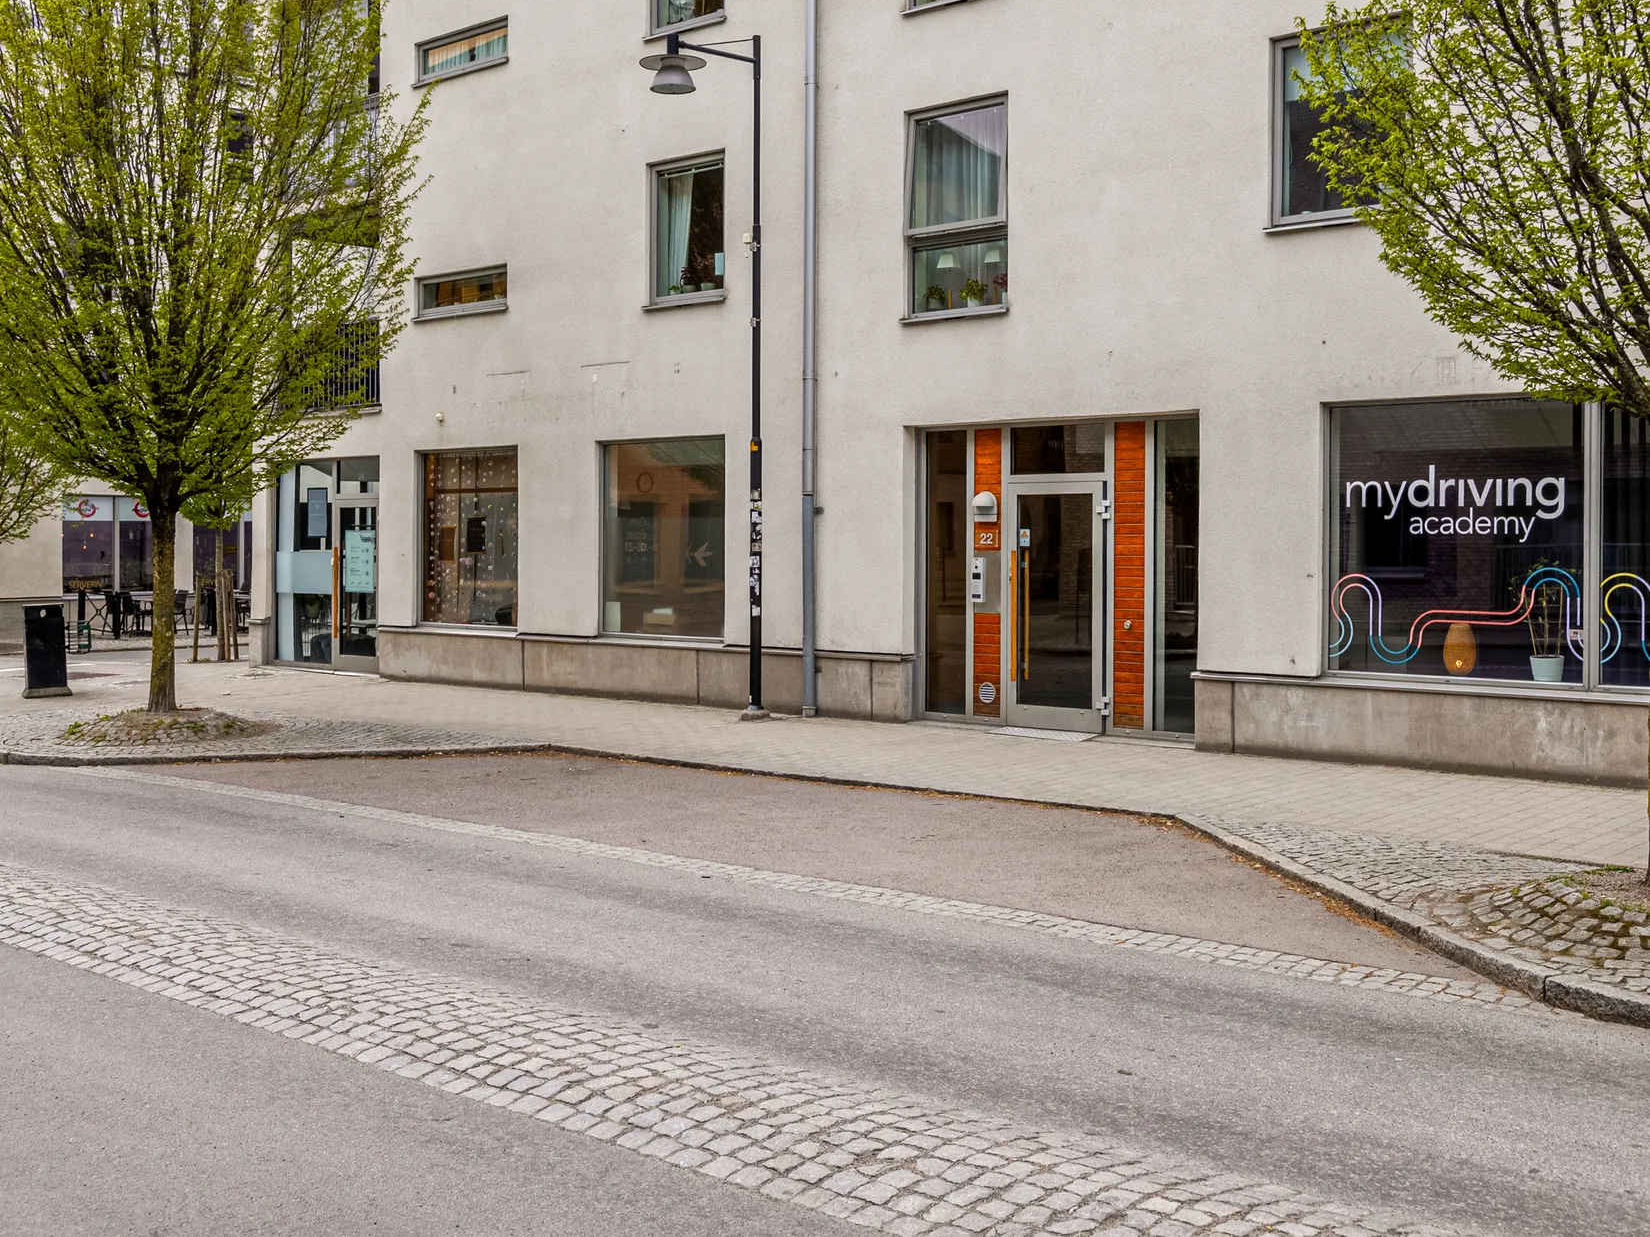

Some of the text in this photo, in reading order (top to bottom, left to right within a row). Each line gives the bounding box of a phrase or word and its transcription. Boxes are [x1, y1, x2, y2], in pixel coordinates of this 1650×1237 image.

[357, 472, 365, 480] 24
[1345, 464, 1566, 520] mydriving
[1409, 507, 1536, 543] academy
[980, 533, 993, 544] 22
